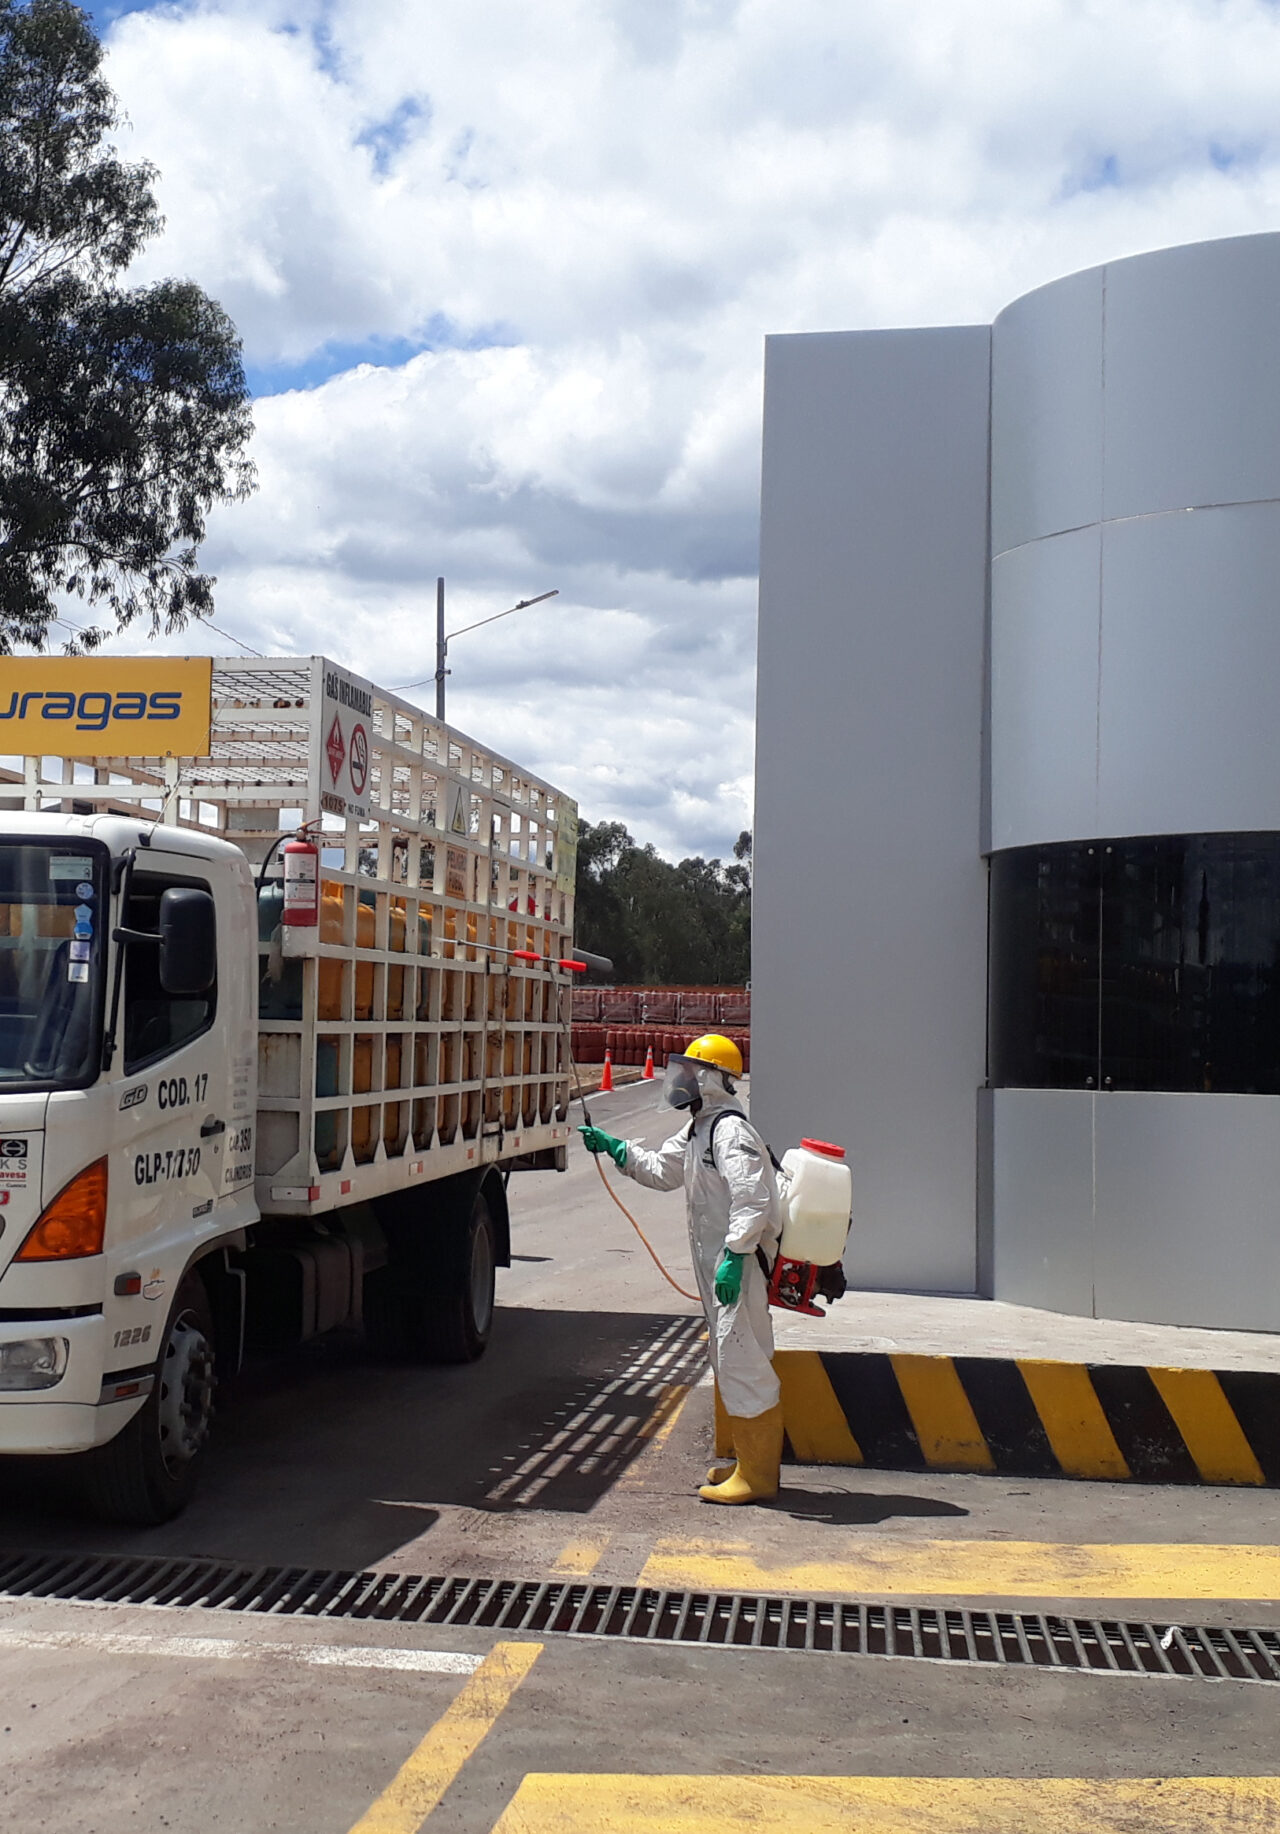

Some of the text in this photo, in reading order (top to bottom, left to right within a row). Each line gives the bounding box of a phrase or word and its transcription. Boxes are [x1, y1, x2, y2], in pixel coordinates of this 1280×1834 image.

[326, 671, 338, 700] GAS
[158, 1077, 190, 1110] COD.
[195, 1073, 208, 1102] 17
[113, 1324, 152, 1348] 1226
